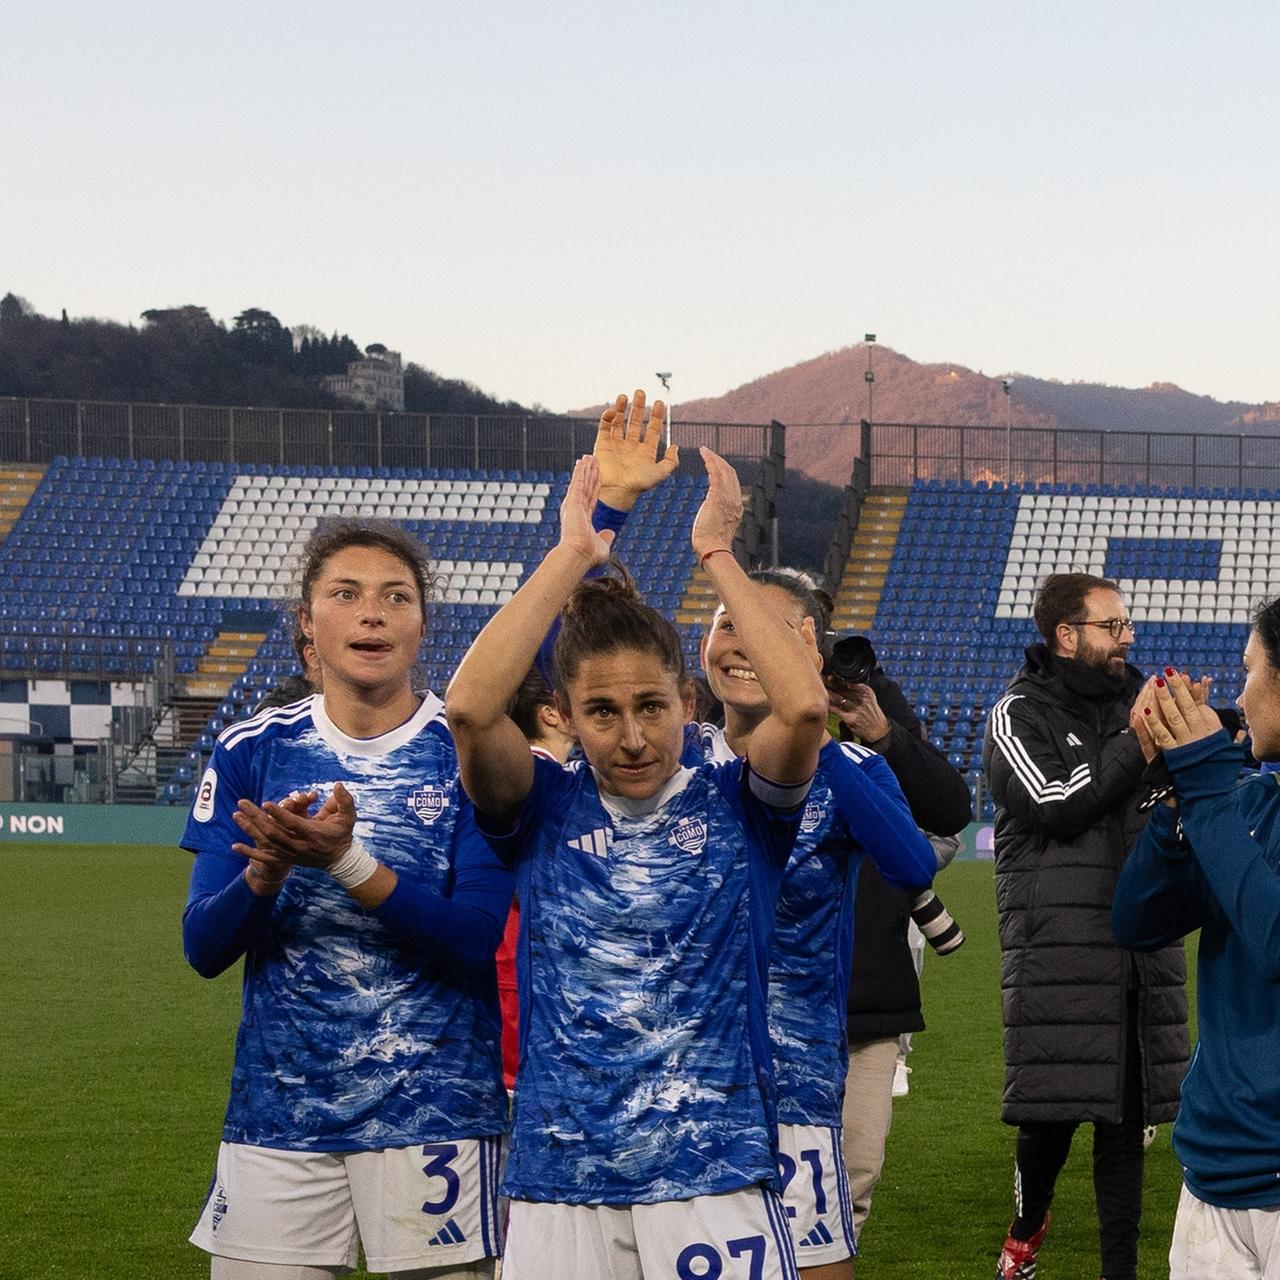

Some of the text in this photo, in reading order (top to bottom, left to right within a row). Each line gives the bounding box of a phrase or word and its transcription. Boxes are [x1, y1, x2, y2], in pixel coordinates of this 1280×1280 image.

[416, 797, 441, 808] COMO
[9, 815, 64, 833] NON
[676, 826, 703, 842] COMO
[422, 1144, 461, 1214] 3
